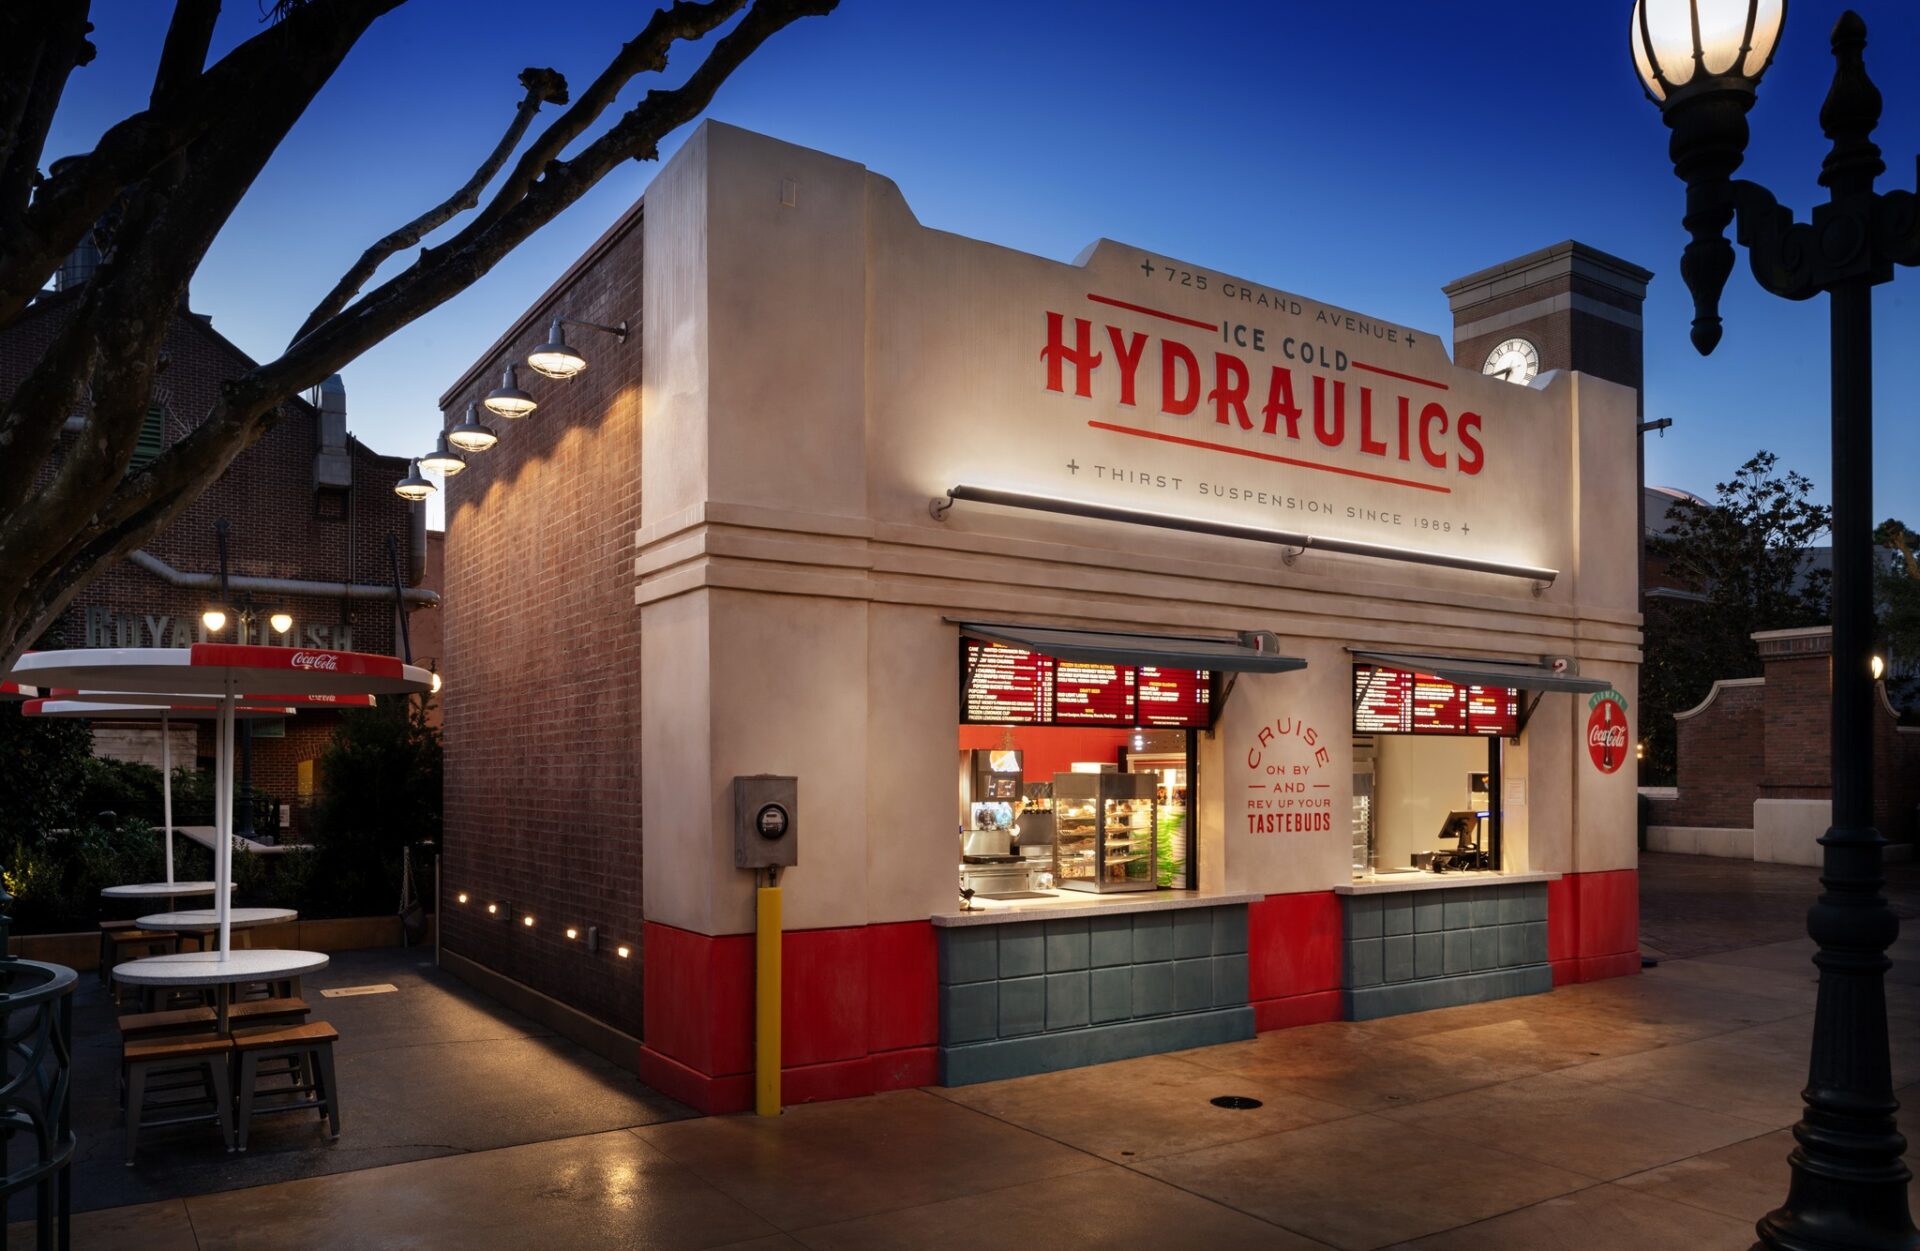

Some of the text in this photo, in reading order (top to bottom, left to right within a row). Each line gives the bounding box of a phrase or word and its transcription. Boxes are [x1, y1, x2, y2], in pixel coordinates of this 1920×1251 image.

[1165, 267, 1397, 342] 725 GRAND AVENUE
[1223, 321, 1347, 371] ICE COLD
[1040, 311, 1484, 475] HYDRAULICS
[1094, 465, 1451, 533] THIRST SUSPENSION SINCE 1989
[291, 651, 338, 670] Coca-Cola
[1247, 717, 1329, 769] CRUISE
[1589, 725, 1626, 748] Coca-Cola
[1266, 765, 1310, 775] ON BY
[1273, 782, 1305, 793] AND
[1248, 799, 1331, 809] REV UP YOUR
[1248, 812, 1331, 834] TASTEBUDS
